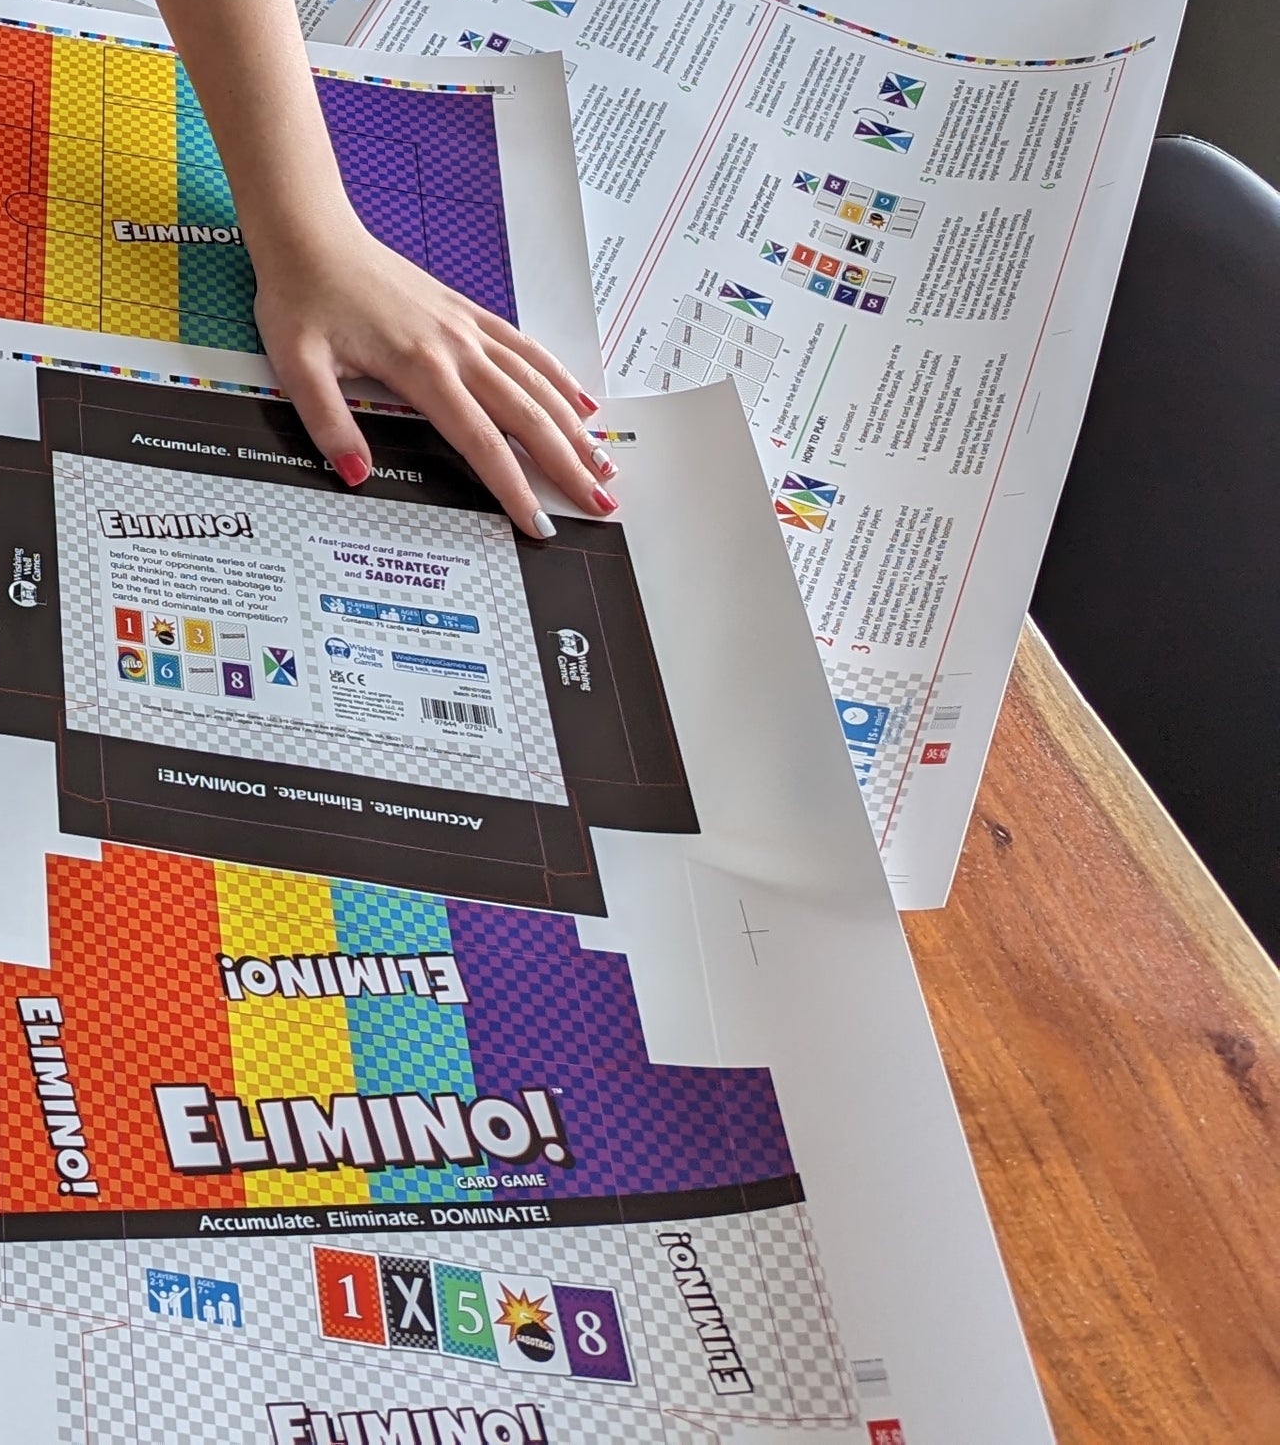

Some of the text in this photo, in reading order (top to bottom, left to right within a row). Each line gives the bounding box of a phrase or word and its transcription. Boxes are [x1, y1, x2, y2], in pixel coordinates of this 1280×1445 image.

[112, 220, 244, 246] ELIMINO!
[851, 237, 866, 253] X
[131, 433, 423, 483] Accumulate. Eliminate. DNATE!
[802, 444, 816, 464] HOW
[809, 434, 820, 444] TO
[98, 509, 254, 539] ELIMINO!
[308, 535, 470, 566] A fast-paced card game featuring
[377, 557, 450, 577] STRATEGY
[344, 569, 446, 590] and SABOTAGE!
[157, 768, 483, 830] Accumulate. Eliminate. DOMINATE!
[220, 953, 469, 1004] ELIMINO!
[17, 996, 100, 1198] ELIMINO!
[152, 1083, 576, 1176] ELIMINO!
[456, 1174, 548, 1190] CARD GAME
[199, 1205, 550, 1233] Accumulate. Eliminate. DOMINATE!
[337, 1275, 362, 1320] 1
[392, 1274, 433, 1331] X
[458, 1291, 484, 1335] 5
[657, 1231, 753, 1395] ELIMINO!
[577, 1310, 606, 1356] 8
[267, 1401, 549, 1445] ELIMINO!
